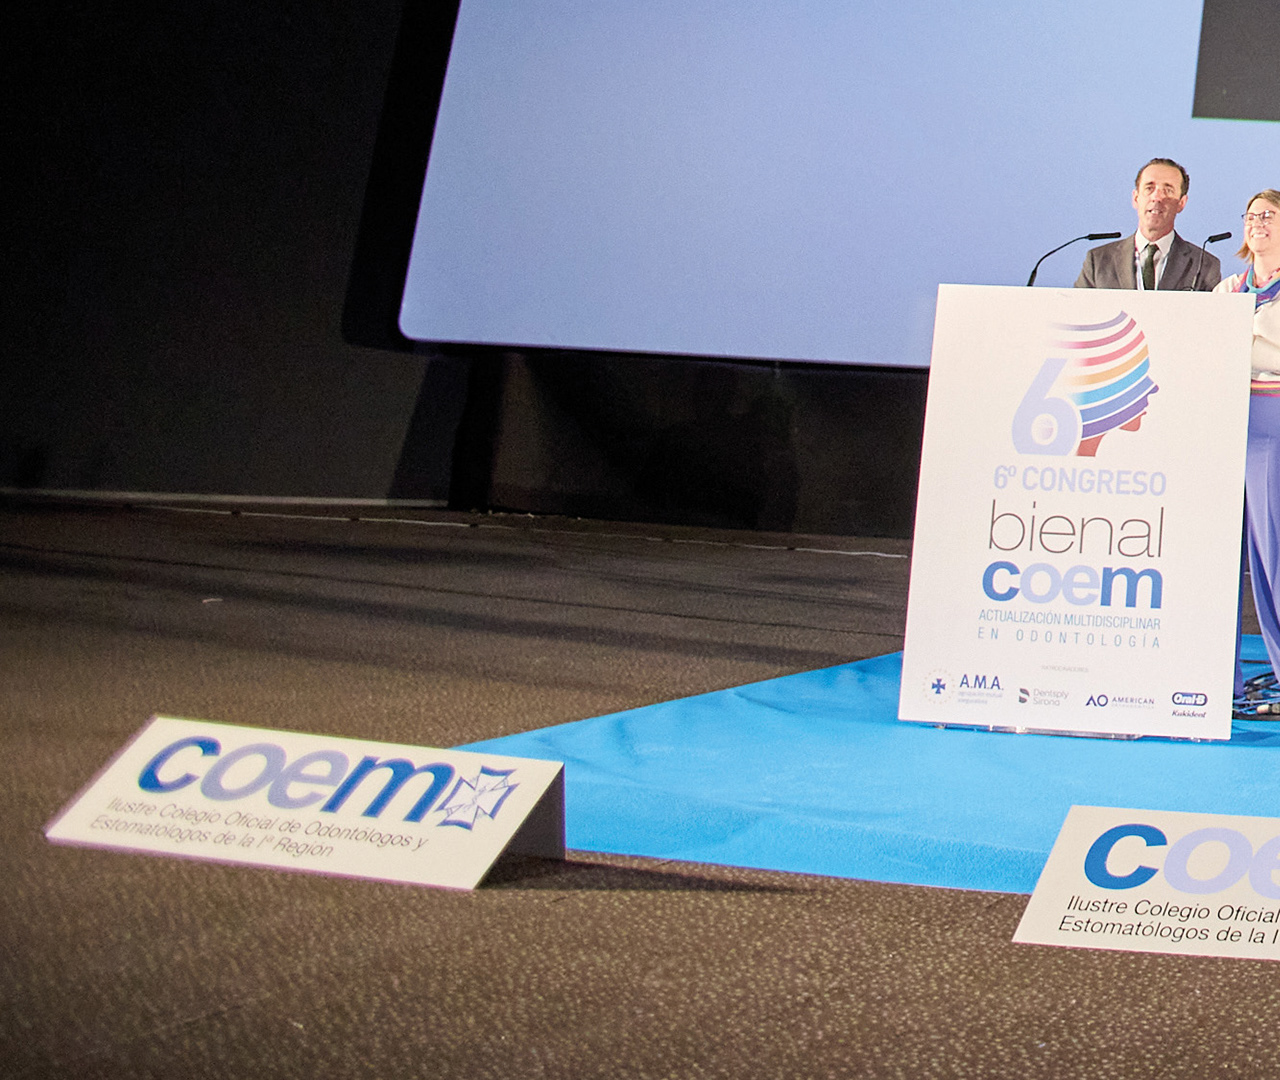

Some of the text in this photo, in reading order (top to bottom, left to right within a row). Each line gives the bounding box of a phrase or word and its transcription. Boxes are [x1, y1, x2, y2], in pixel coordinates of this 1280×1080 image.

[1011, 358, 1079, 457] 6
[1022, 466, 1167, 496] CONGRESO
[988, 499, 1164, 558] bienal
[982, 560, 1163, 609] coem
[978, 609, 1161, 630] ACTUALIZACIÓN MULTIDISCIPLINAR
[977, 626, 1160, 649] EN ODONTOLOGÍA
[959, 674, 1005, 691] A.M.A.
[1033, 688, 1069, 700] Dentsply
[1033, 697, 1060, 707] Sirona
[1112, 696, 1155, 705] AMERICAN
[138, 735, 455, 823] coem
[90, 814, 211, 843] Estomatólogos
[213, 830, 236, 845] de
[237, 833, 255, 848] la
[272, 837, 334, 857] Región
[107, 797, 429, 852] Ilustre Colegio Oficial de Odontólogos y
[1067, 895, 1128, 914] Ilustre
[1134, 899, 1210, 922] Colegio
[1217, 904, 1280, 924] Oficial
[1058, 915, 1209, 943] Estomatólogos
[1216, 926, 1242, 943] de
[1248, 928, 1266, 944] la
